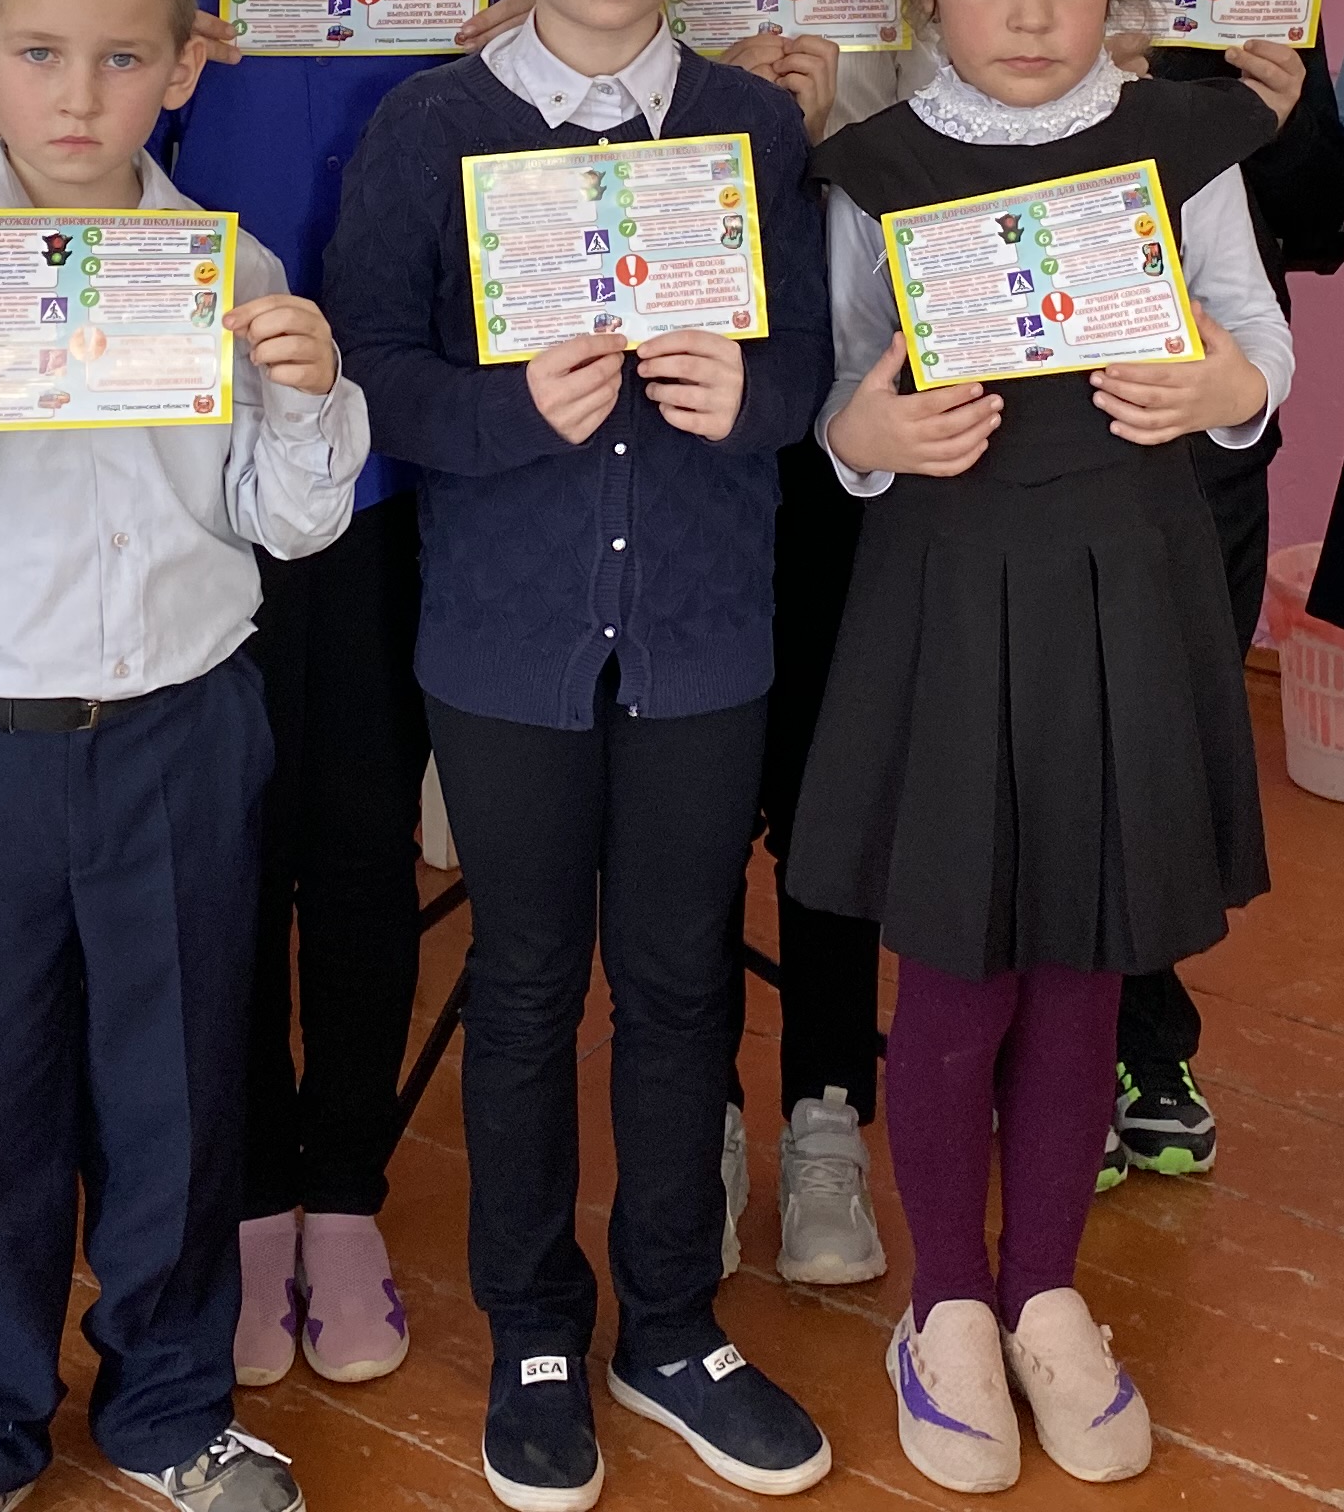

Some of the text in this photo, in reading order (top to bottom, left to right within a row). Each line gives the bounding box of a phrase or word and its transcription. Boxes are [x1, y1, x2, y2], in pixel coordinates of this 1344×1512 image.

[618, 166, 628, 177] 5
[620, 194, 630, 205] 6
[1033, 205, 1043, 216] 5
[55, 217, 115, 226] ДВИЖЕНИЯ
[119, 218, 141, 226] ДЛЯ
[143, 218, 218, 227] ШКОЛЬНИКОВ
[623, 223, 633, 234] 7
[87, 231, 98, 243] 5
[485, 237, 496, 247] 2
[900, 231, 909, 242] 1
[1038, 233, 1049, 244] 6
[85, 261, 97, 272] 6
[1044, 261, 1054, 272] 7
[489, 285, 499, 296] 3
[910, 284, 922, 294] 2
[84, 292, 96, 304] 7
[492, 320, 504, 332] 4
[919, 325, 928, 334] 3
[924, 354, 935, 364] 4
[715, 1350, 741, 1371] GCA
[526, 1362, 563, 1376] GCA
